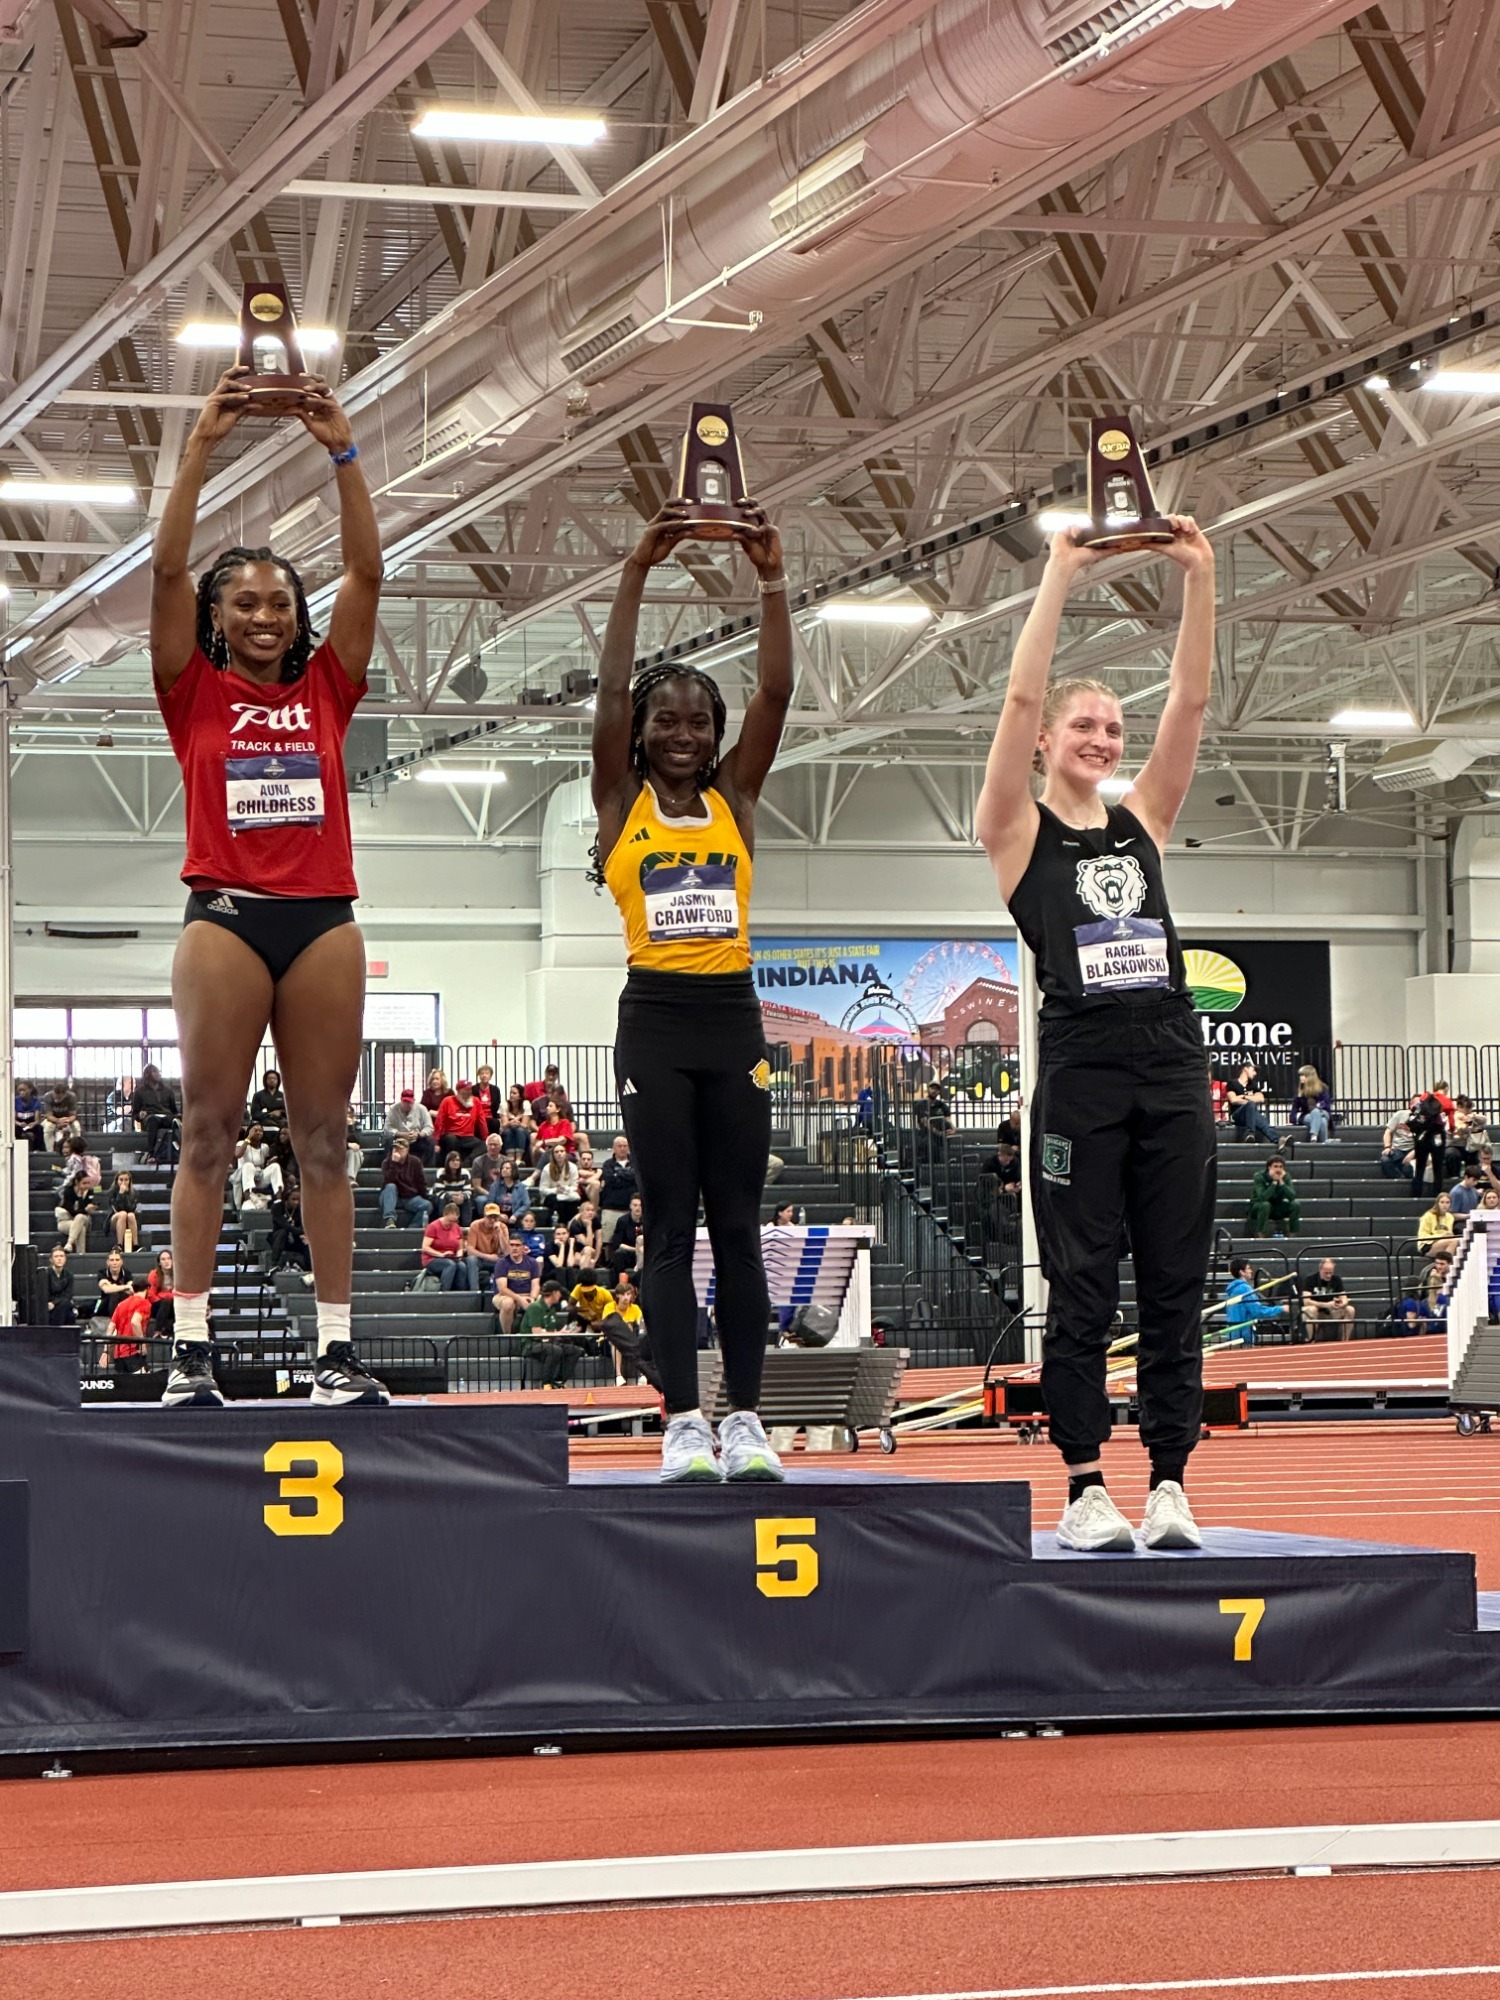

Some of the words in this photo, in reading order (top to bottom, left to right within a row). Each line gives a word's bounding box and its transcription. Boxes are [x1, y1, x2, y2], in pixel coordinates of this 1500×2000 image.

[229, 702, 311, 734] Pitt
[231, 740, 271, 752] TRACK
[274, 742, 283, 752] &
[285, 741, 315, 752] FIELD
[260, 784, 291, 796] AUNA
[236, 796, 316, 815] CHILDRESS
[207, 903, 239, 915] adidas
[670, 893, 715, 907] JASMYN
[655, 908, 732, 926] CRAWFORD
[772, 949, 792, 960] OTHER
[793, 947, 814, 959] STATES
[828, 946, 842, 958] JUST
[849, 945, 866, 957] STATE
[866, 944, 880, 956] FAIR
[1105, 943, 1146, 958] RACHEL
[757, 963, 881, 988] INDIANA
[1086, 957, 1166, 979] BLASKOWSKI
[959, 998, 1005, 1014] SWINE
[1201, 1016, 1292, 1047] tone
[263, 1440, 345, 1536] 3
[754, 1517, 818, 1598] 5
[1218, 1598, 1265, 1661] 7
